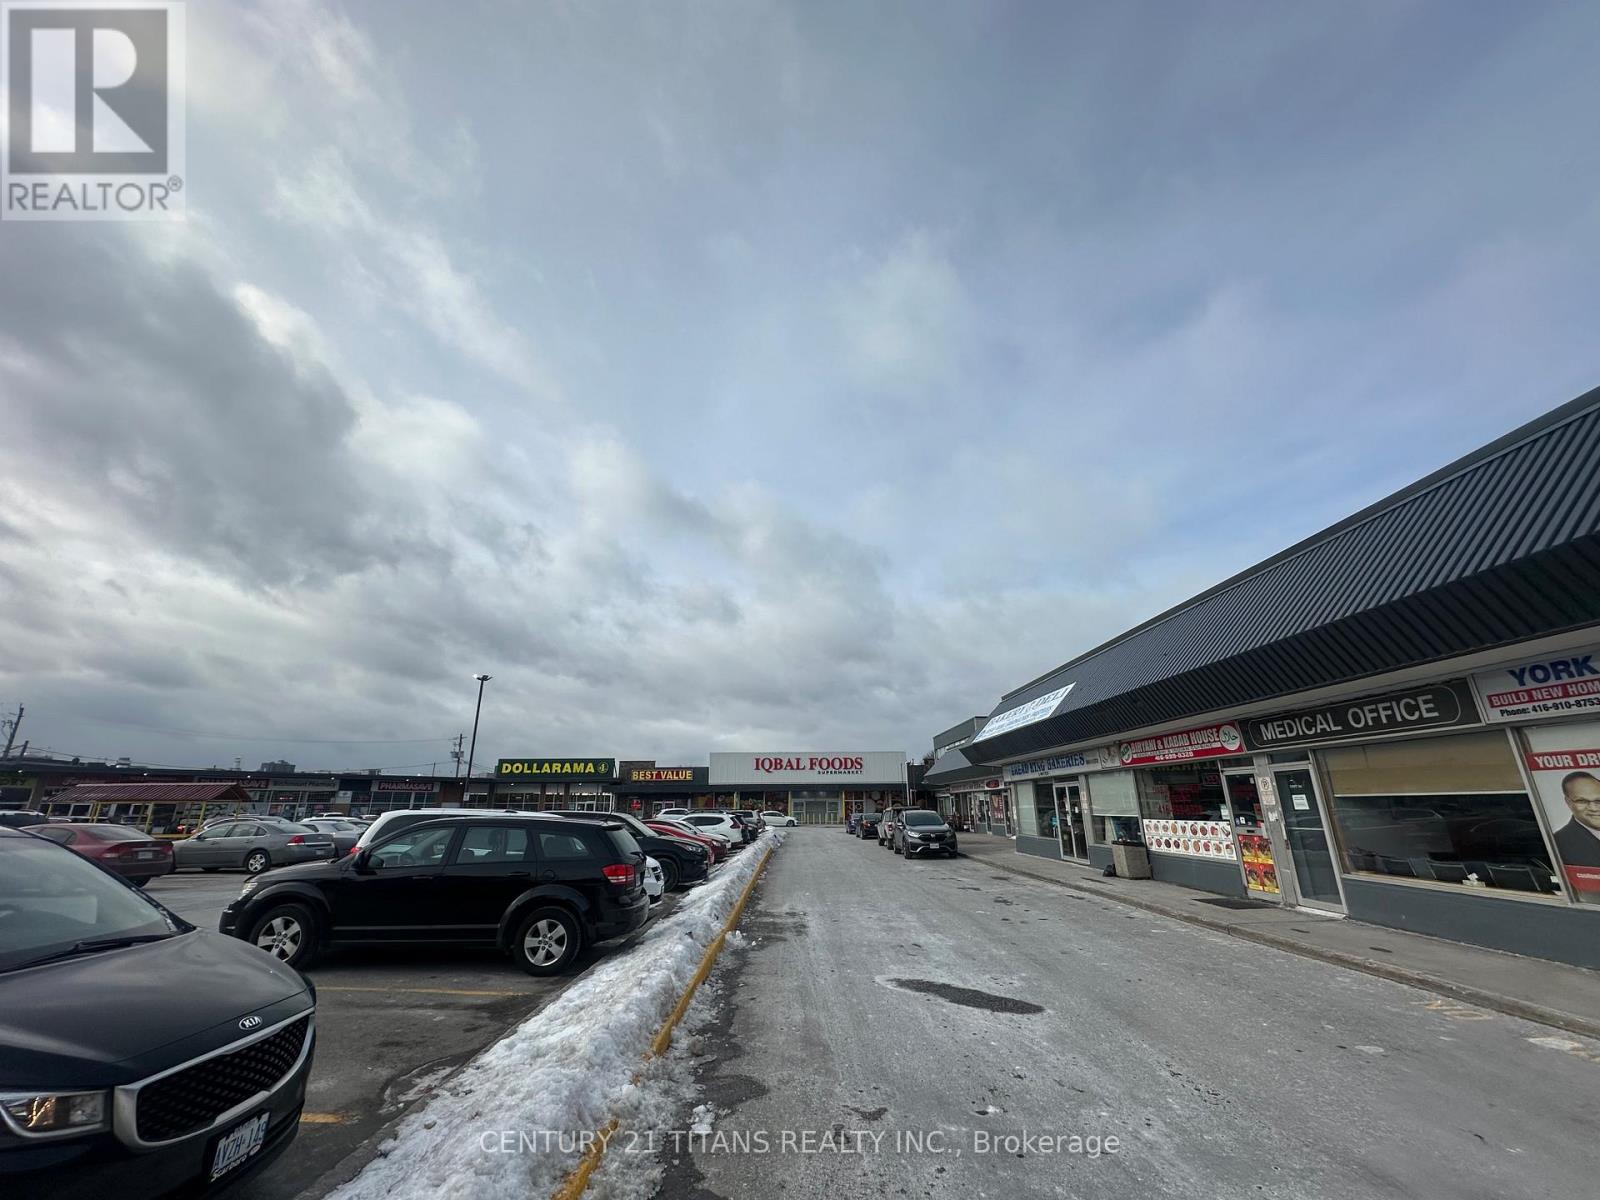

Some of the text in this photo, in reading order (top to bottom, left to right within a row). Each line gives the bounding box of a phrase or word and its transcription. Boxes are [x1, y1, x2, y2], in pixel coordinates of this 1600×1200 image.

[1507, 655, 1600, 687] YORK
[1491, 692, 1529, 706] BUILD
[1531, 686, 1563, 700] NEW
[1259, 694, 1439, 741] MEDICAL OFFICE
[1500, 708, 1531, 717] Phone:
[1163, 733, 1190, 749] KABAB
[1190, 728, 1220, 745] HOUSE
[501, 762, 595, 774] DOLLARAMA
[754, 756, 863, 773] IQBAL FOODS
[1030, 760, 1045, 773] KING
[1047, 752, 1085, 772] BAKERIES
[1534, 754, 1574, 768] YOUR
[632, 769, 693, 781] BEST VALUE
[379, 782, 433, 791] PHARMASAVE
[243, 1016, 262, 1028] KIA
